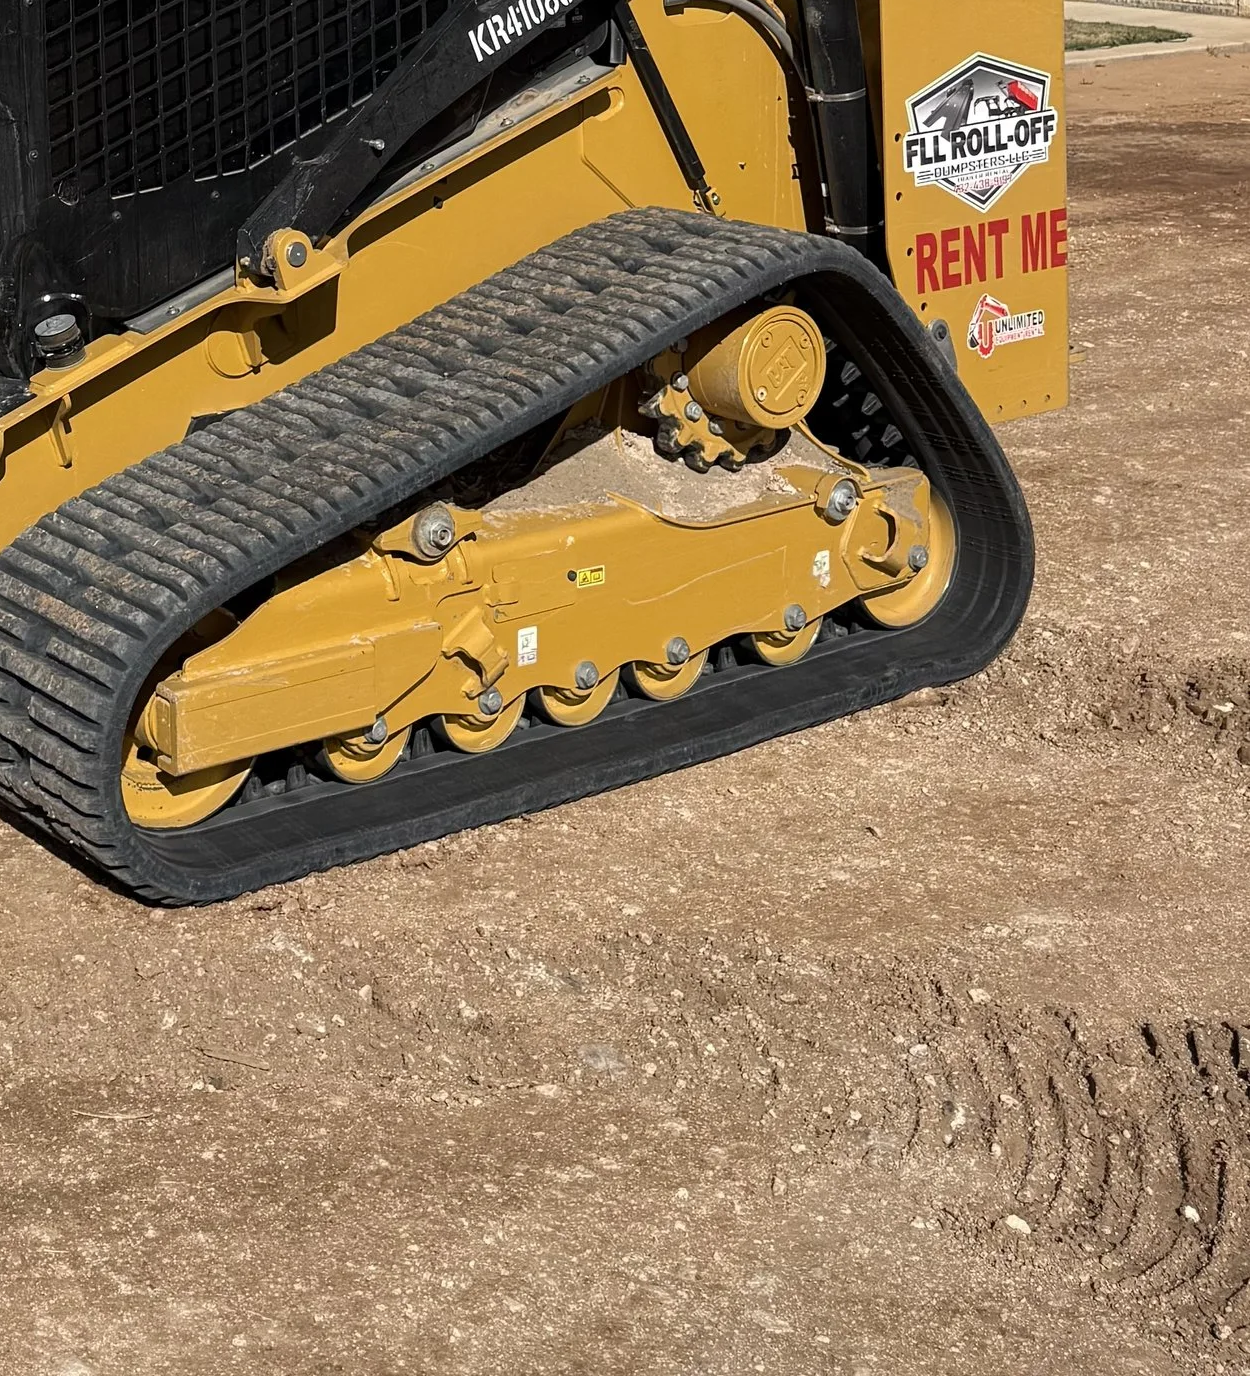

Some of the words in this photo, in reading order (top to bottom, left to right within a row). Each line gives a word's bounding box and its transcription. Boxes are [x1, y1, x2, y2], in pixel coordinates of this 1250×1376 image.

[906, 135, 947, 169] FLL
[951, 114, 1055, 161] ROLL-OFF
[915, 218, 1009, 295] RENT
[1021, 207, 1068, 274] ME
[995, 311, 1044, 334] UNLIMITED
